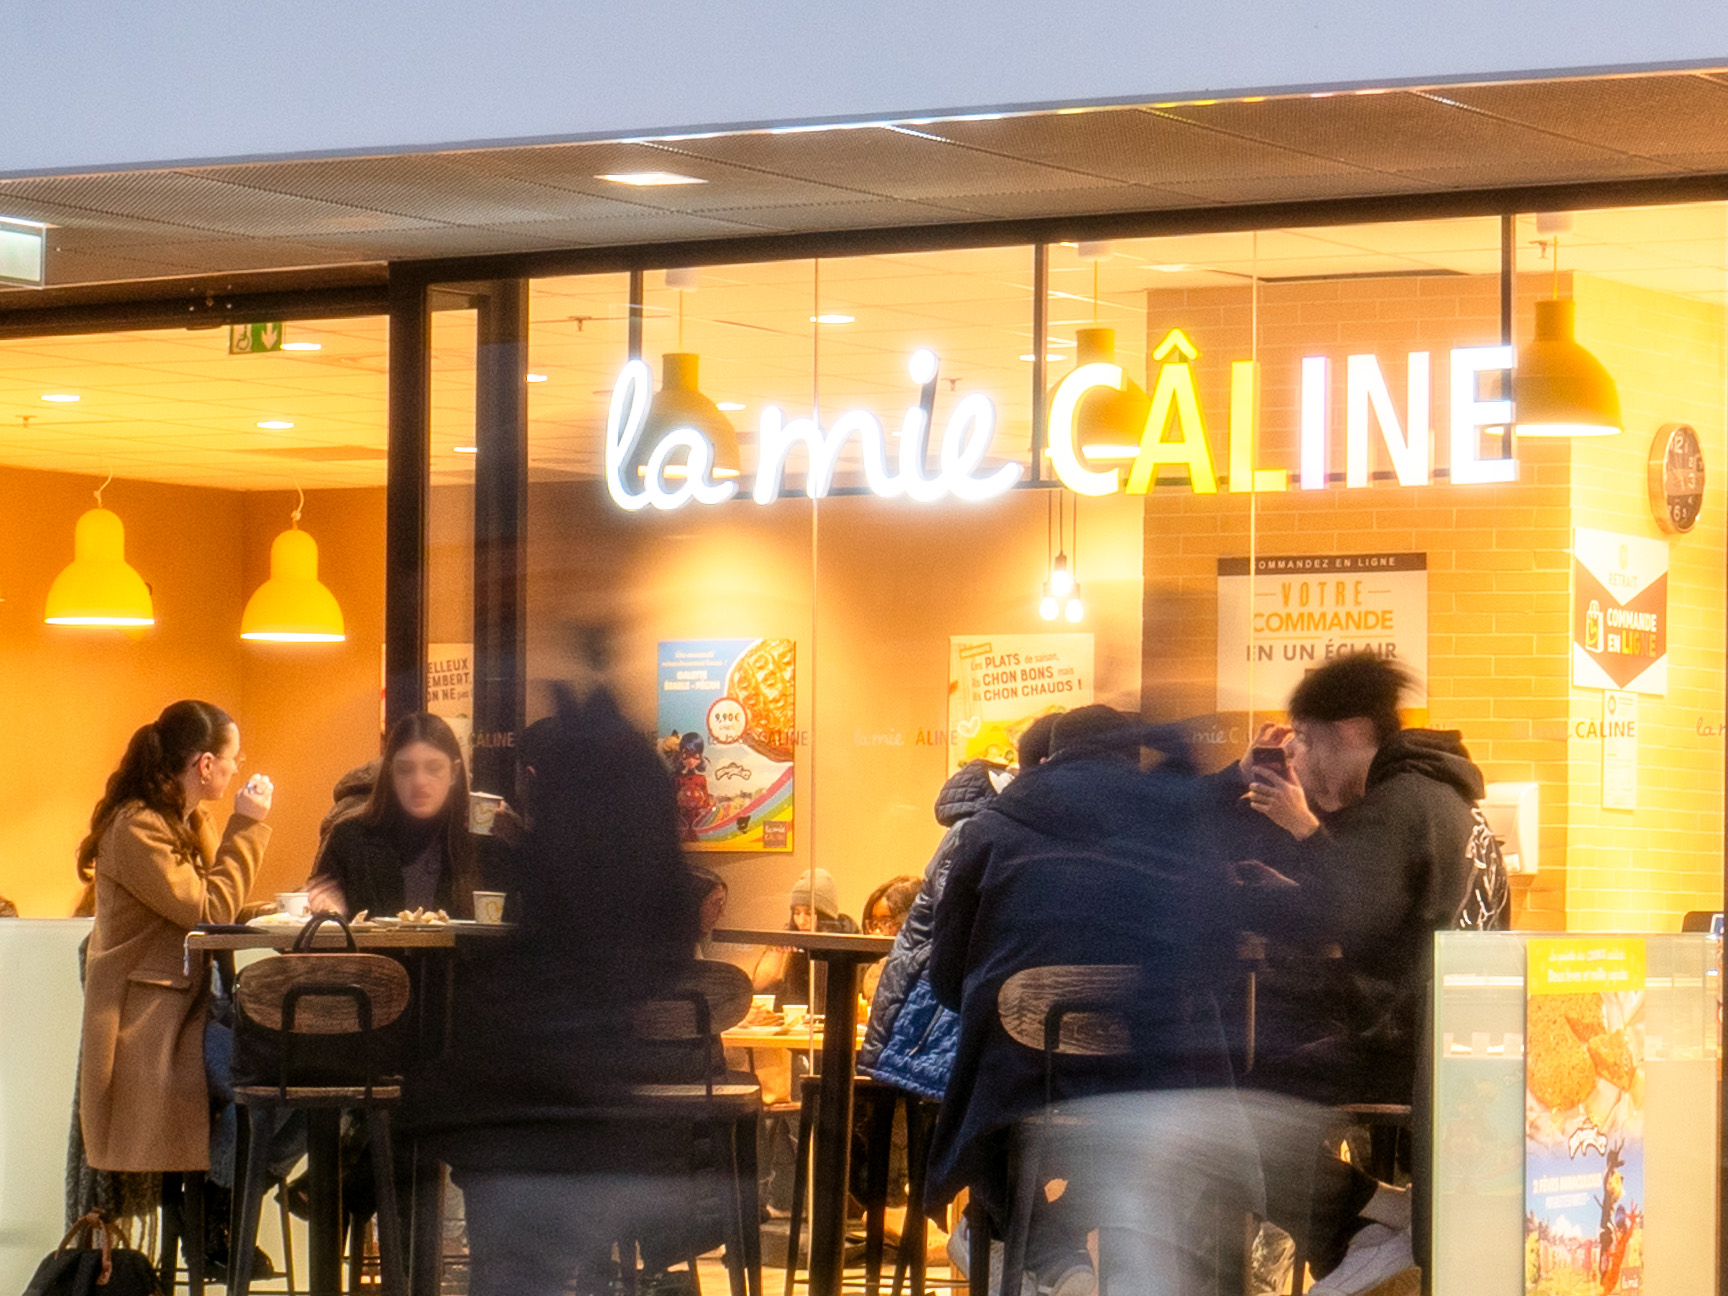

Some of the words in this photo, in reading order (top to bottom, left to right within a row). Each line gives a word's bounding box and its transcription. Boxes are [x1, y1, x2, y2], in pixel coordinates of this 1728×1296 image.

[605, 358, 739, 512] la
[753, 348, 1024, 505] mie
[1044, 328, 1520, 497] CÂLINE
[1335, 559, 1351, 568] EN
[1358, 557, 1397, 568] LIGNE
[1608, 571, 1638, 589] RETRAIT
[1281, 581, 1363, 607] VOTRE
[1252, 609, 1394, 633] COMMANDE
[1607, 607, 1658, 633] COMMANDE
[1283, 644, 1316, 661] UN
[1607, 633, 1621, 654] EN
[1622, 630, 1658, 657] LIGNE
[984, 653, 1021, 669] PLATS
[983, 671, 1017, 687] CHON
[1020, 666, 1054, 681] BONS
[983, 684, 1019, 702] CHON
[1022, 680, 1073, 697] CHAUDS
[910, 726, 959, 746] ÂLINE
